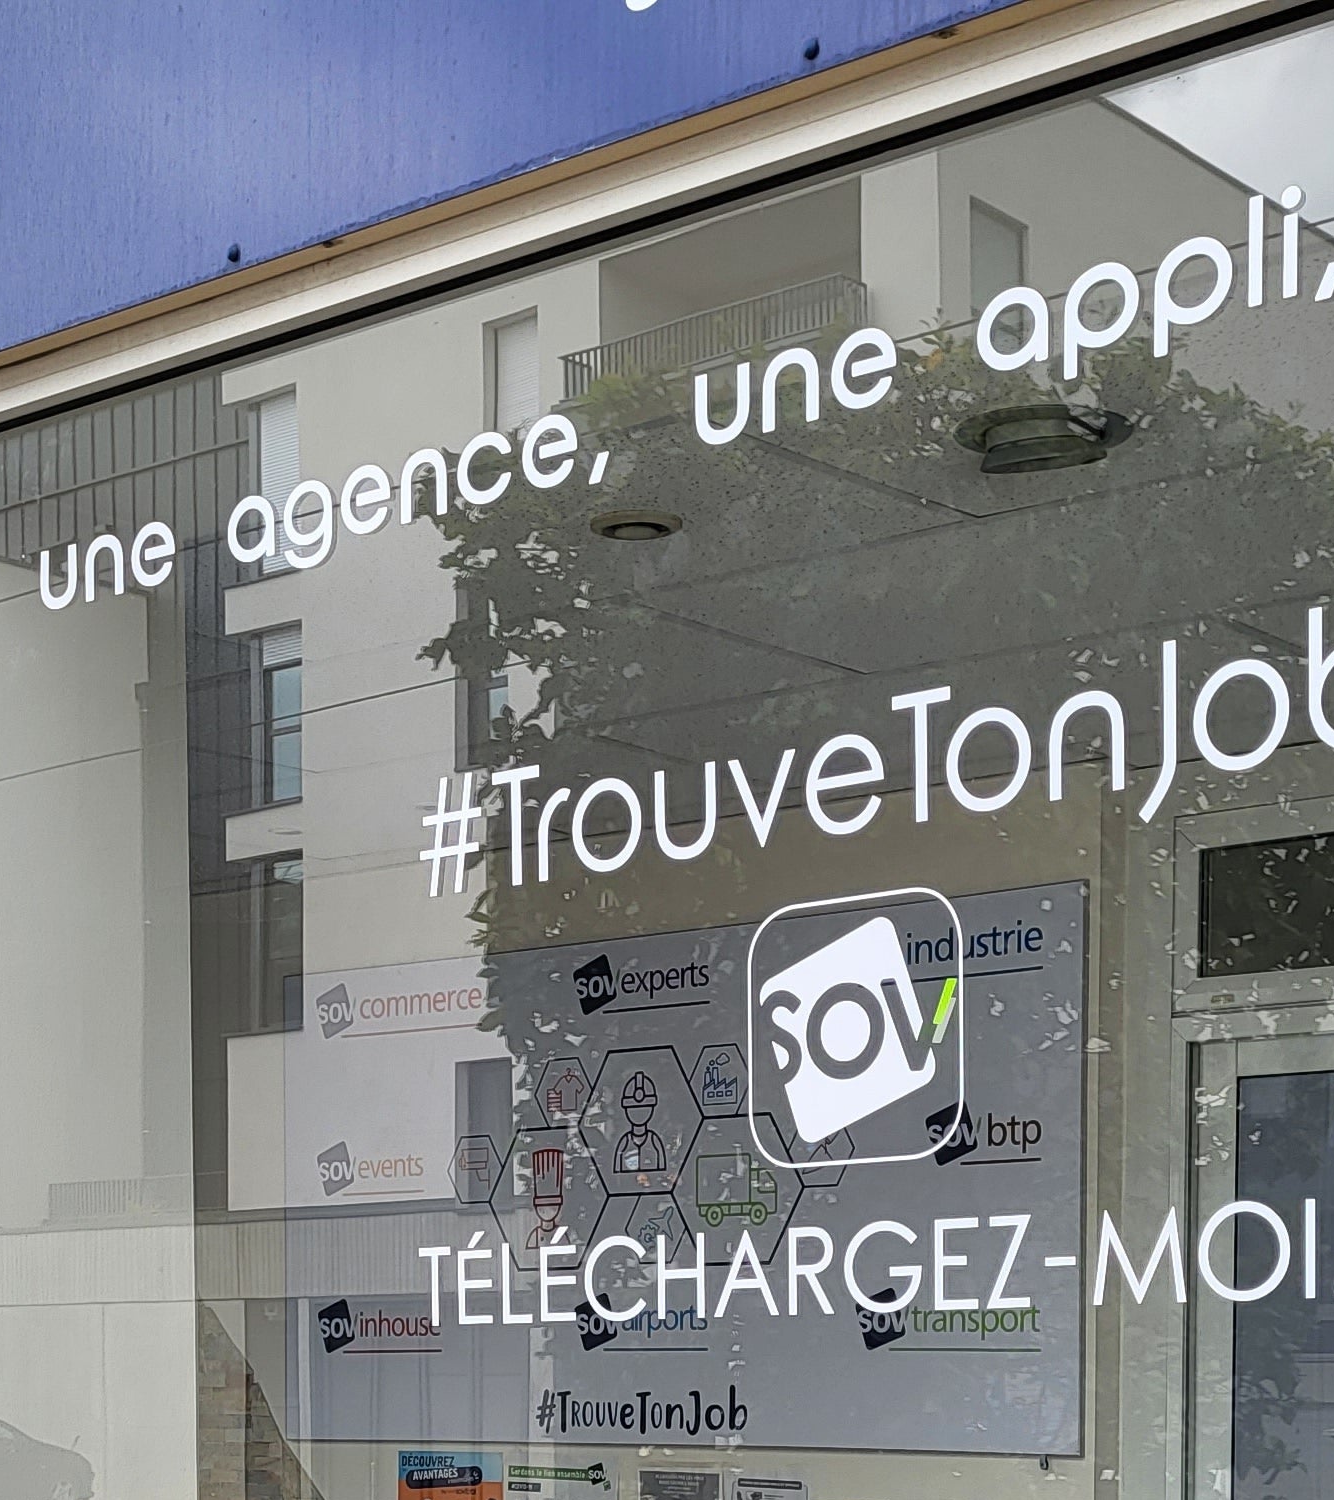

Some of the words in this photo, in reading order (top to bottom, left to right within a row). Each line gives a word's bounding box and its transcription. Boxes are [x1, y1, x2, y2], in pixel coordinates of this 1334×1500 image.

[40, 521, 176, 610] une
[227, 407, 612, 571] agence,
[693, 324, 897, 446] une
[907, 920, 1044, 965] industrie
[620, 958, 711, 998] experts
[359, 986, 483, 1020] commerce
[987, 1113, 1042, 1154] btp
[357, 1153, 424, 1181] events
[359, 1309, 442, 1339] inhouse
[911, 1304, 1041, 1341] transport
[401, 1453, 455, 1467] DÉCOUVREZ
[413, 1468, 459, 1481] AVANTAGES
